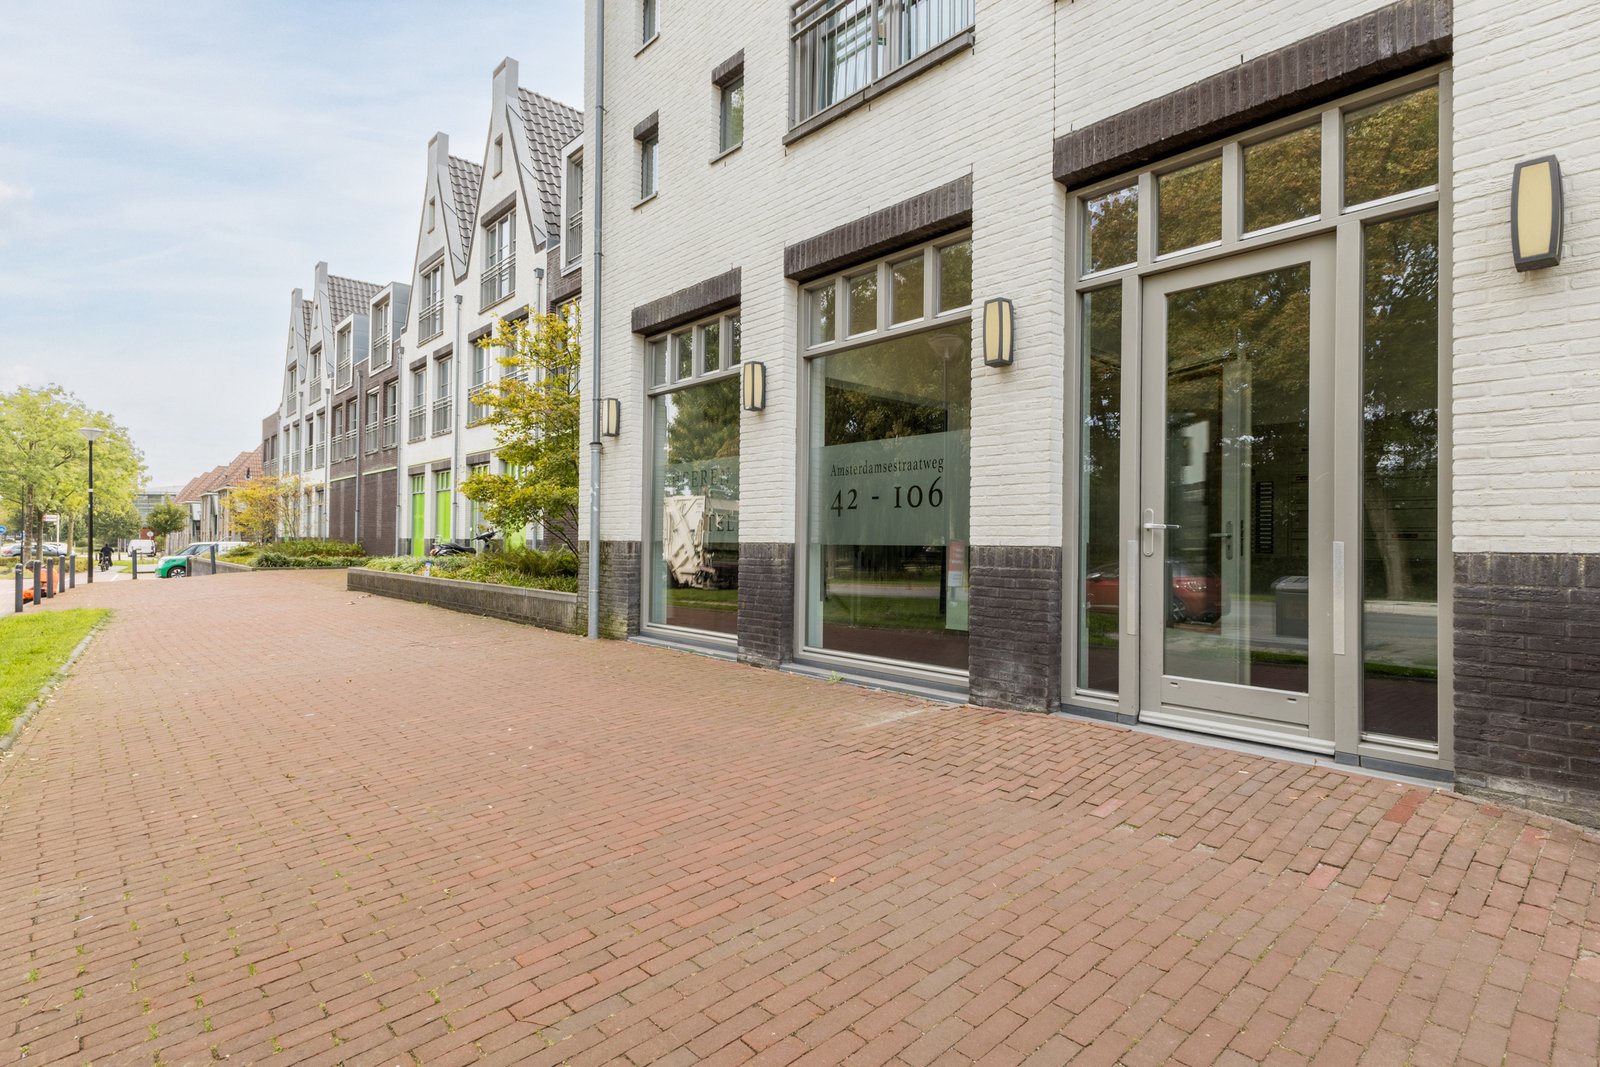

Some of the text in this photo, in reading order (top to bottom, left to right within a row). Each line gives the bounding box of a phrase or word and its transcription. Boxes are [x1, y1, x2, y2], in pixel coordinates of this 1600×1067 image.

[830, 458, 944, 477] Amsterdamsestraatweg
[830, 488, 858, 517] 42
[893, 476, 943, 508] 106
